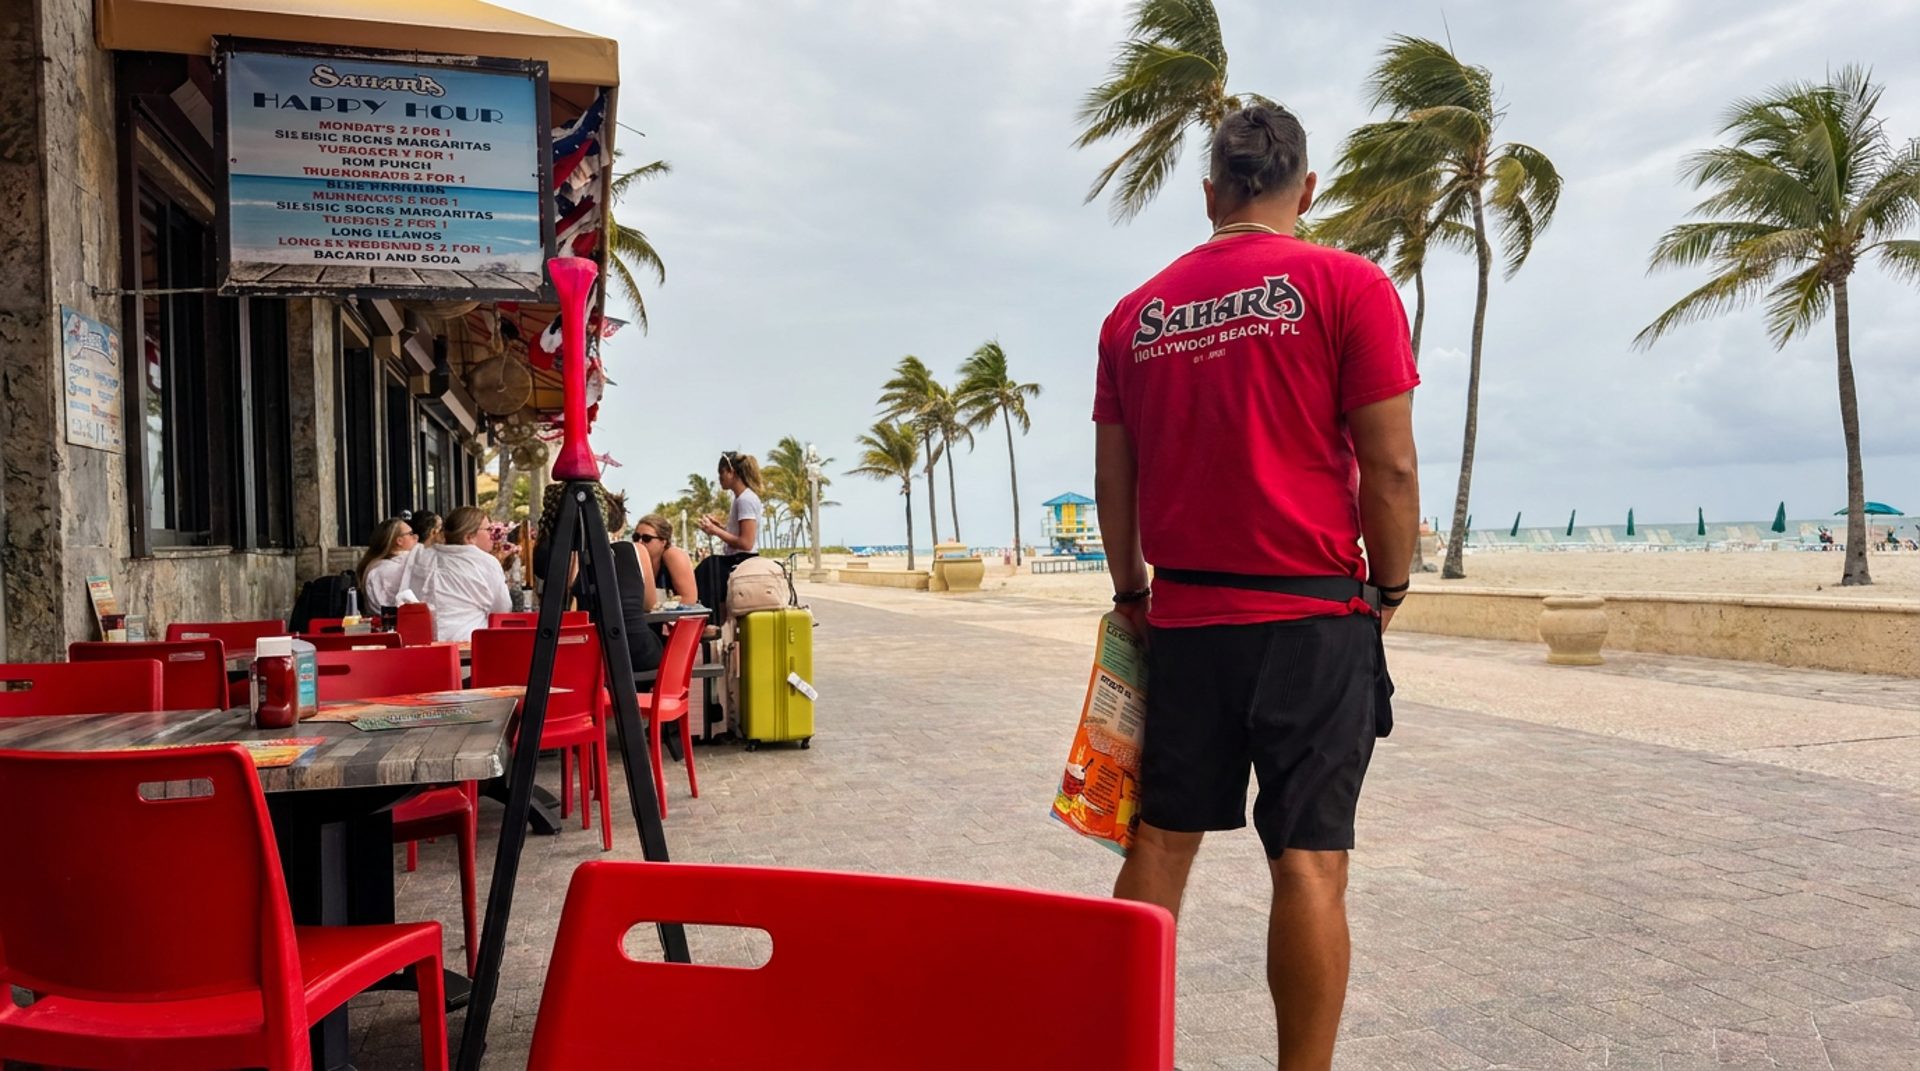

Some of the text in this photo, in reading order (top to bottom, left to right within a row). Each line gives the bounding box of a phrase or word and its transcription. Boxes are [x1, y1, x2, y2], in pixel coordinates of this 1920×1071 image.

[253, 92, 504, 125] HAPPY HOUR
[400, 126, 408, 135] 2
[445, 129, 452, 137] 1
[397, 137, 492, 151] MARGARITAS
[448, 152, 455, 160] 1
[341, 157, 432, 170] ROM PUNCH
[413, 171, 423, 181] 2
[426, 173, 455, 183] FOR
[459, 175, 466, 183] 1
[452, 198, 458, 207] 1
[394, 218, 403, 227] 2
[441, 221, 447, 229] 1
[331, 227, 373, 238] LONG
[278, 237, 321, 247] LONG
[439, 244, 448, 252] 2
[485, 246, 492, 254] 1
[313, 250, 461, 265] BACARDI AND SODA
[1132, 273, 1305, 349] SAHARA
